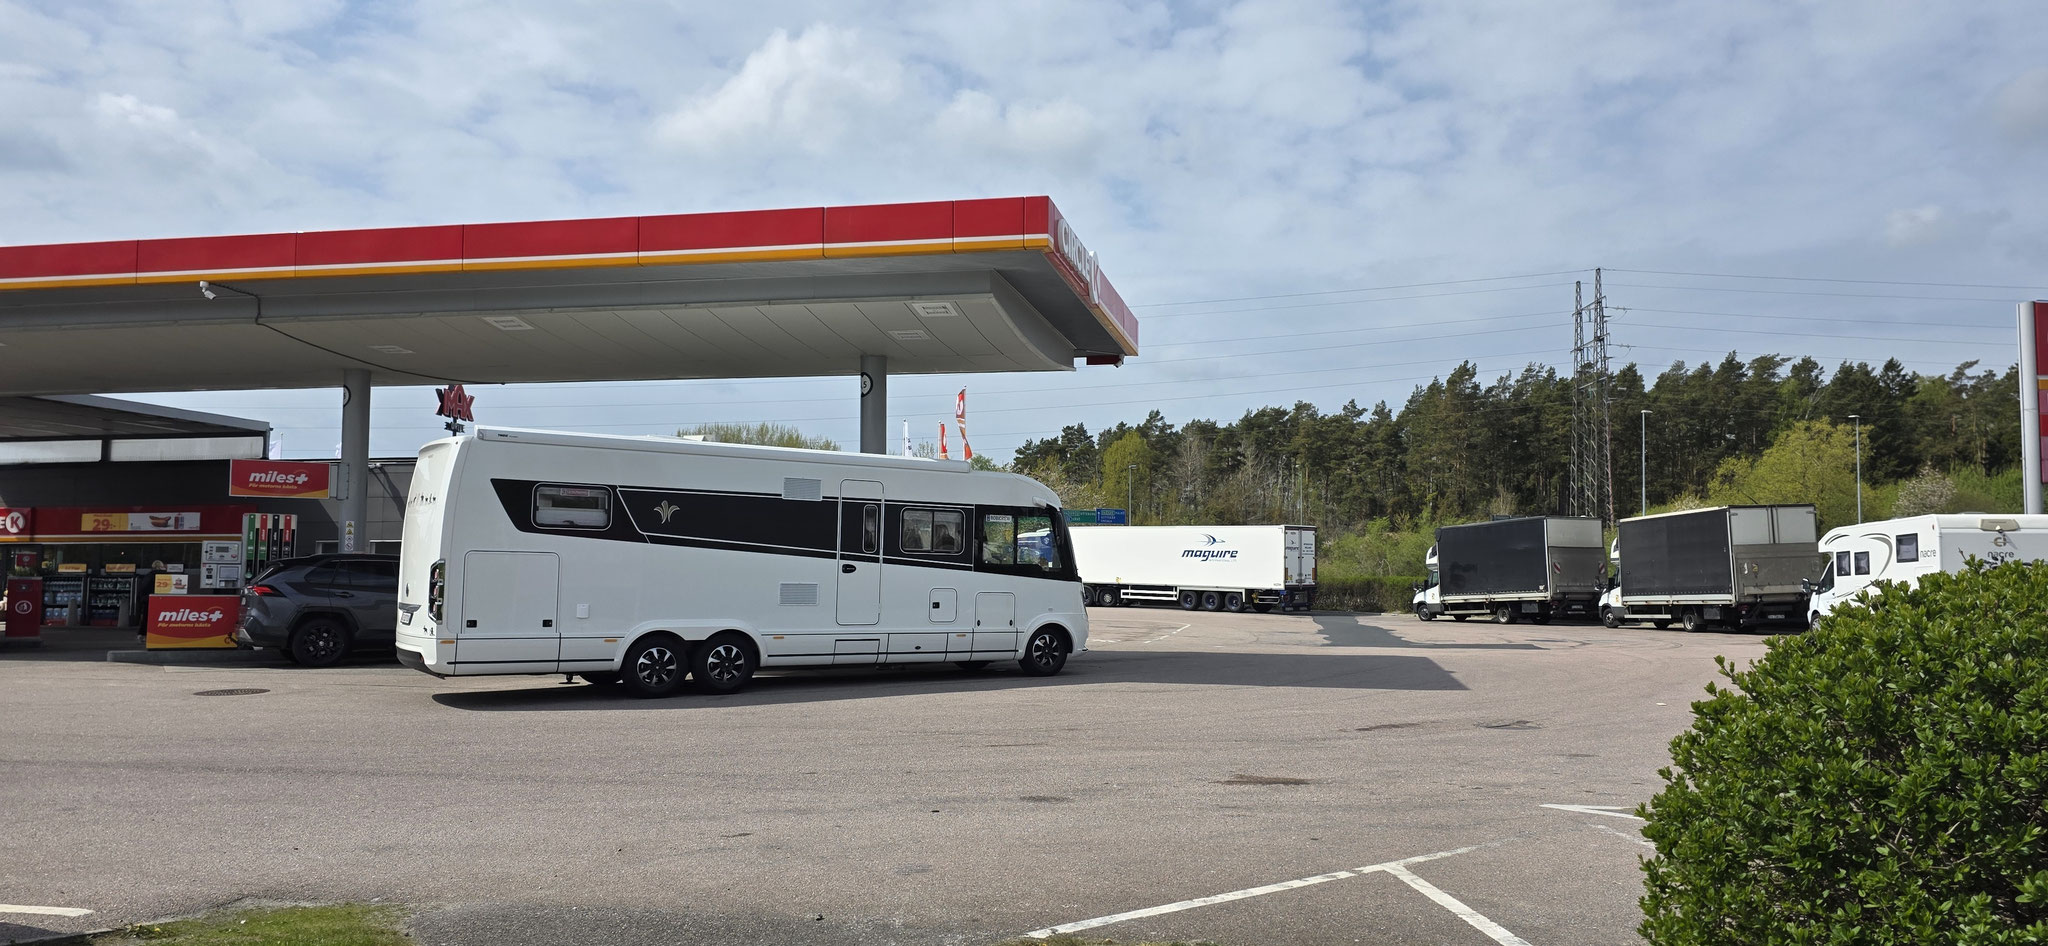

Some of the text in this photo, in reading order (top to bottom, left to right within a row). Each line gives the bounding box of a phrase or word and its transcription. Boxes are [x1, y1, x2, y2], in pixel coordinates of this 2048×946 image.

[1057, 218, 1091, 284] CIRCLE
[443, 384, 475, 422] MAX
[249, 471, 308, 485] miles+
[1181, 549, 1239, 562] maguire
[1919, 549, 1937, 558] nacre
[157, 608, 224, 622] miles+
